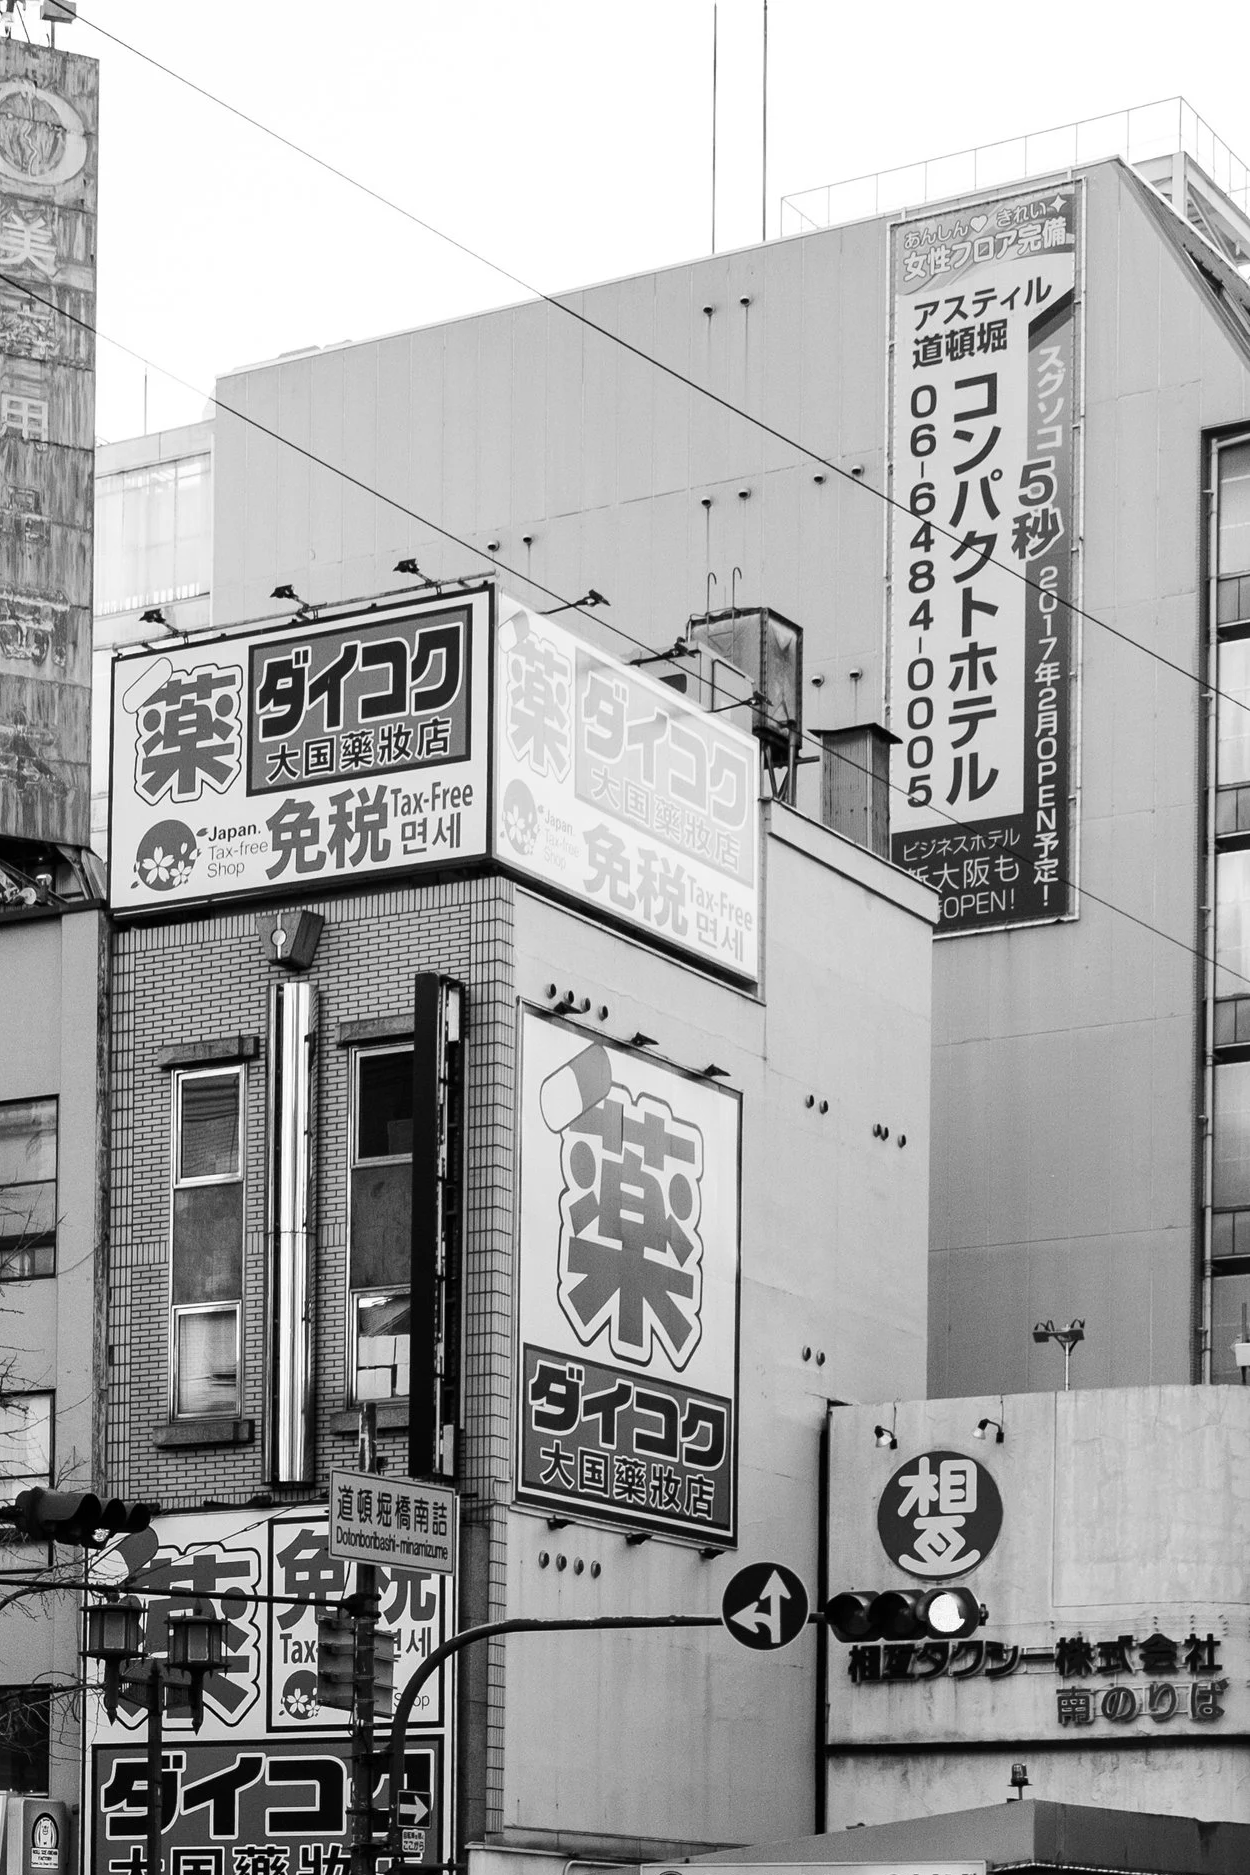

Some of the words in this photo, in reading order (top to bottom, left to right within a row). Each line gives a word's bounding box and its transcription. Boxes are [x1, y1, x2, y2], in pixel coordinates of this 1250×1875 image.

[903, 216, 1068, 282] 女性フロア完備
[904, 218, 970, 249] あんしん
[996, 202, 1047, 229] きれい
[914, 276, 1053, 331] アスティル
[912, 318, 1008, 370] 道頓堀
[906, 384, 938, 808] 06-6484-0005
[945, 372, 1003, 806] コンパクトホテル
[257, 623, 463, 740] ダイコク
[509, 636, 569, 777] 薬
[140, 670, 238, 799] 薬
[582, 671, 749, 831] ダイコク
[390, 780, 474, 818] Tax-Free
[207, 841, 269, 861] Tax-free
[264, 784, 392, 880] 免税
[400, 812, 462, 855] 면세
[903, 827, 1021, 862] ビジネスホテル
[206, 861, 245, 879] Shop
[582, 823, 689, 937] 免税
[687, 871, 753, 932] Tax-Free
[695, 913, 745, 963] 면세
[566, 1098, 696, 1356] 薬
[530, 1362, 727, 1469] ダイコク
[336, 1485, 448, 1538] 道頓堀橋南詰
[335, 1530, 449, 1561] Dotonboribashi-minamizume
[849, 1633, 1224, 1683] 相互タクシー株式会社
[1055, 1678, 1229, 1726] 南のりば
[403, 1840, 425, 1851] ここから
